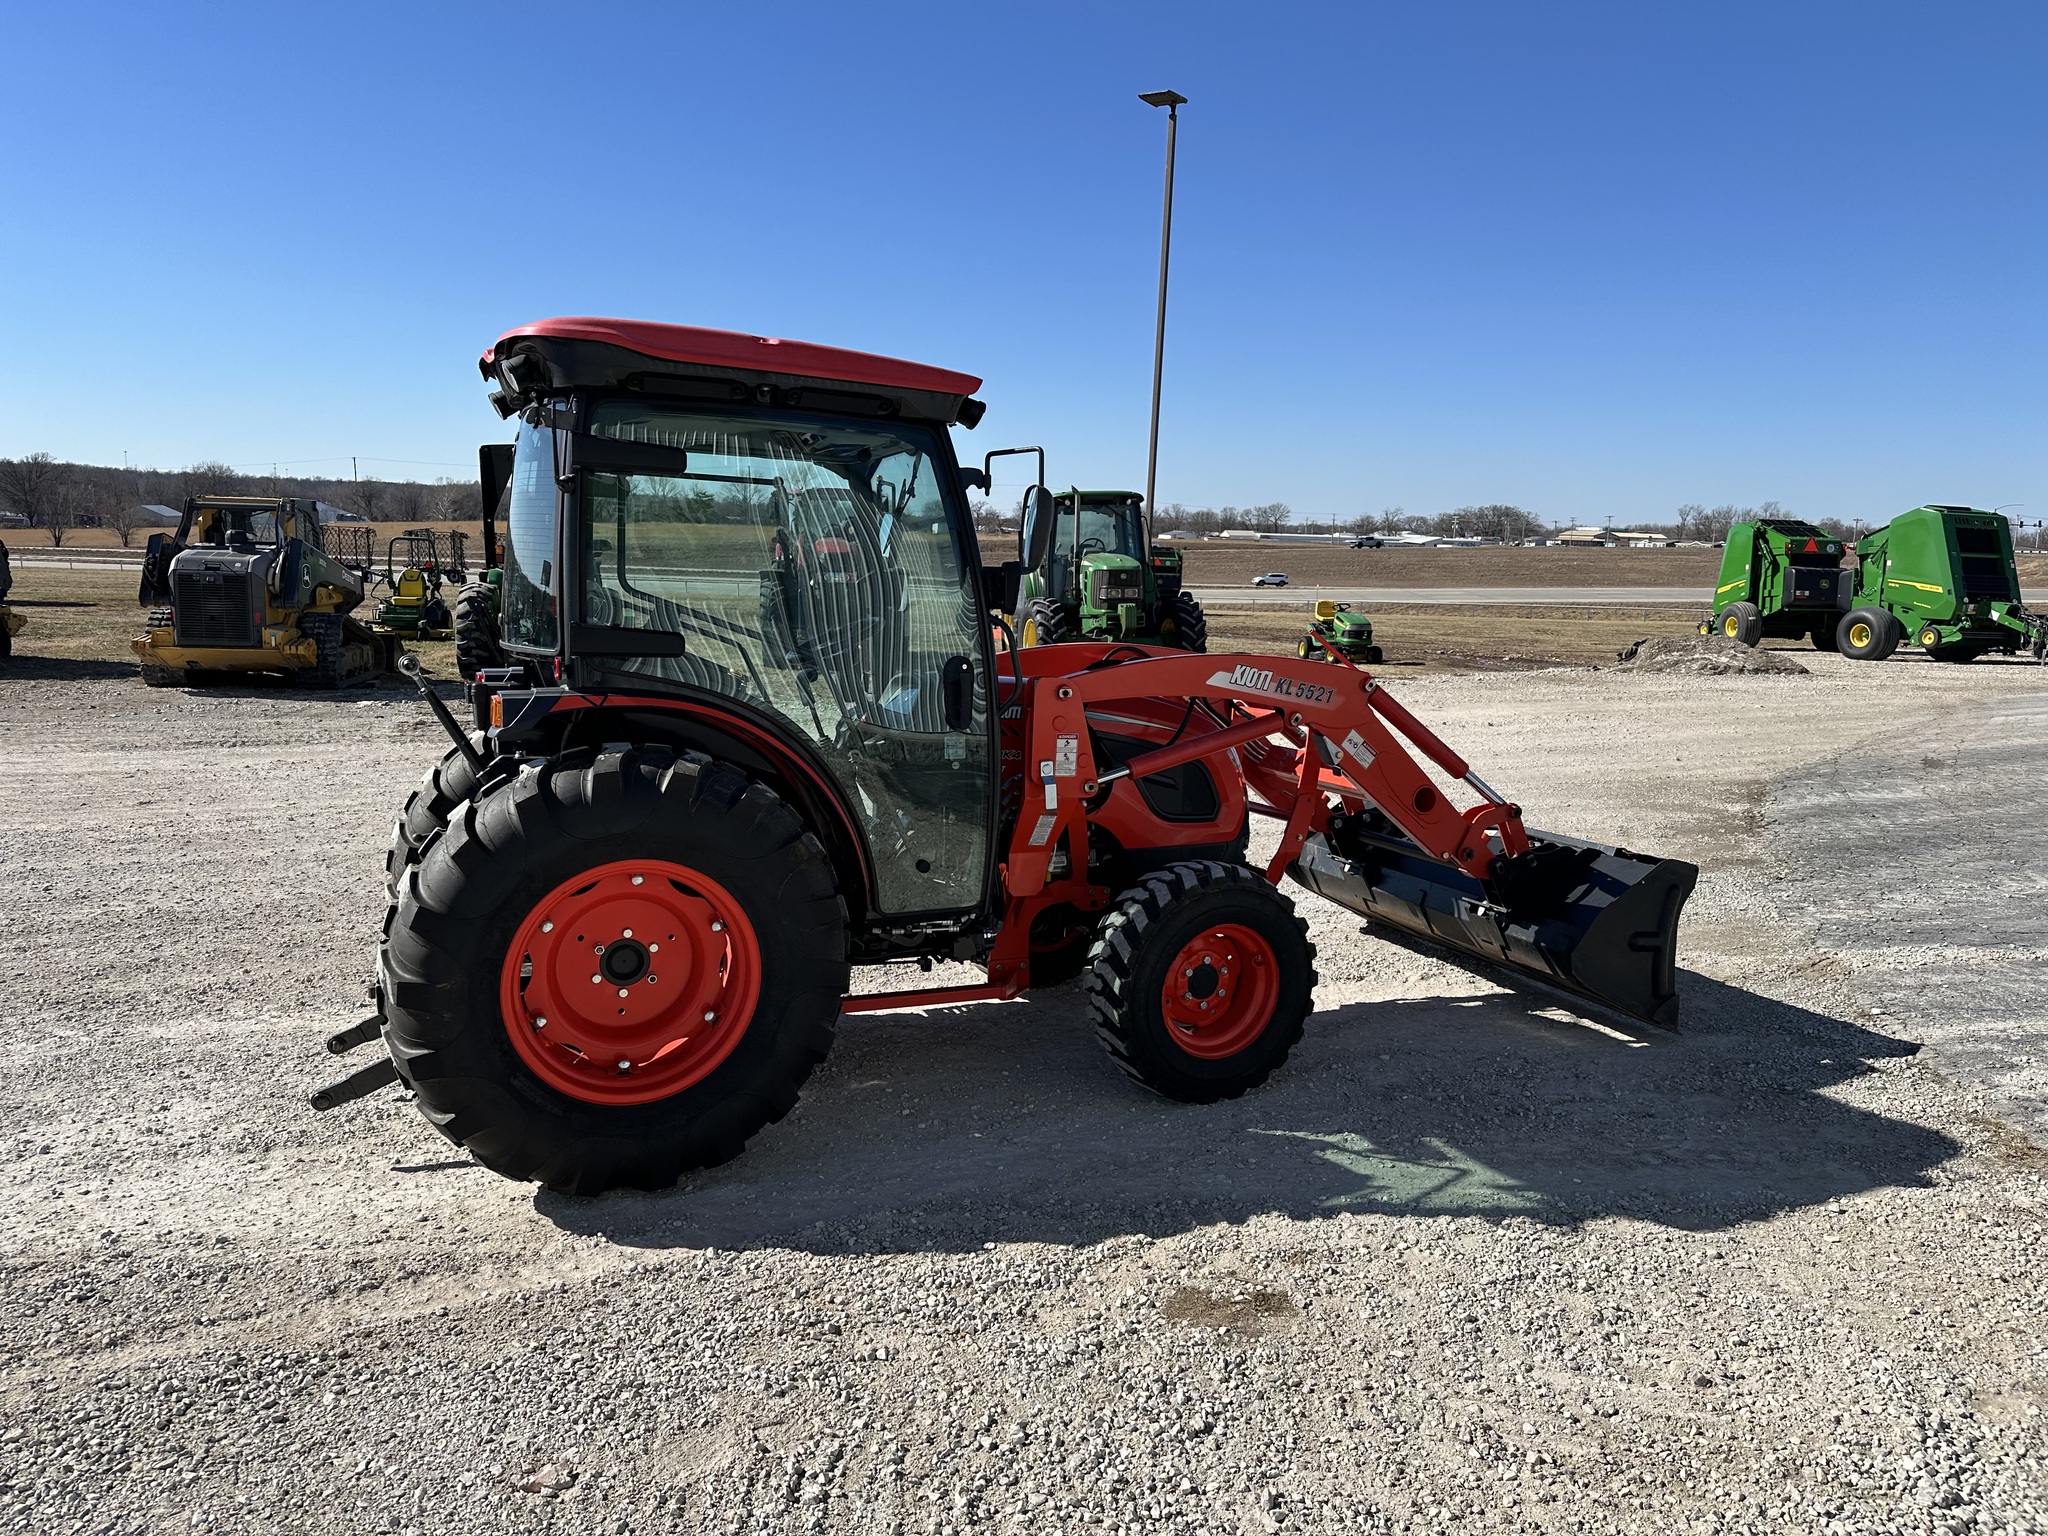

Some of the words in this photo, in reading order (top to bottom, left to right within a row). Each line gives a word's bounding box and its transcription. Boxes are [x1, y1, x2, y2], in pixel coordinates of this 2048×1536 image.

[1230, 664, 1274, 691] KIOTI
[1275, 677, 1292, 696] KL
[1295, 683, 1335, 703] 5521
